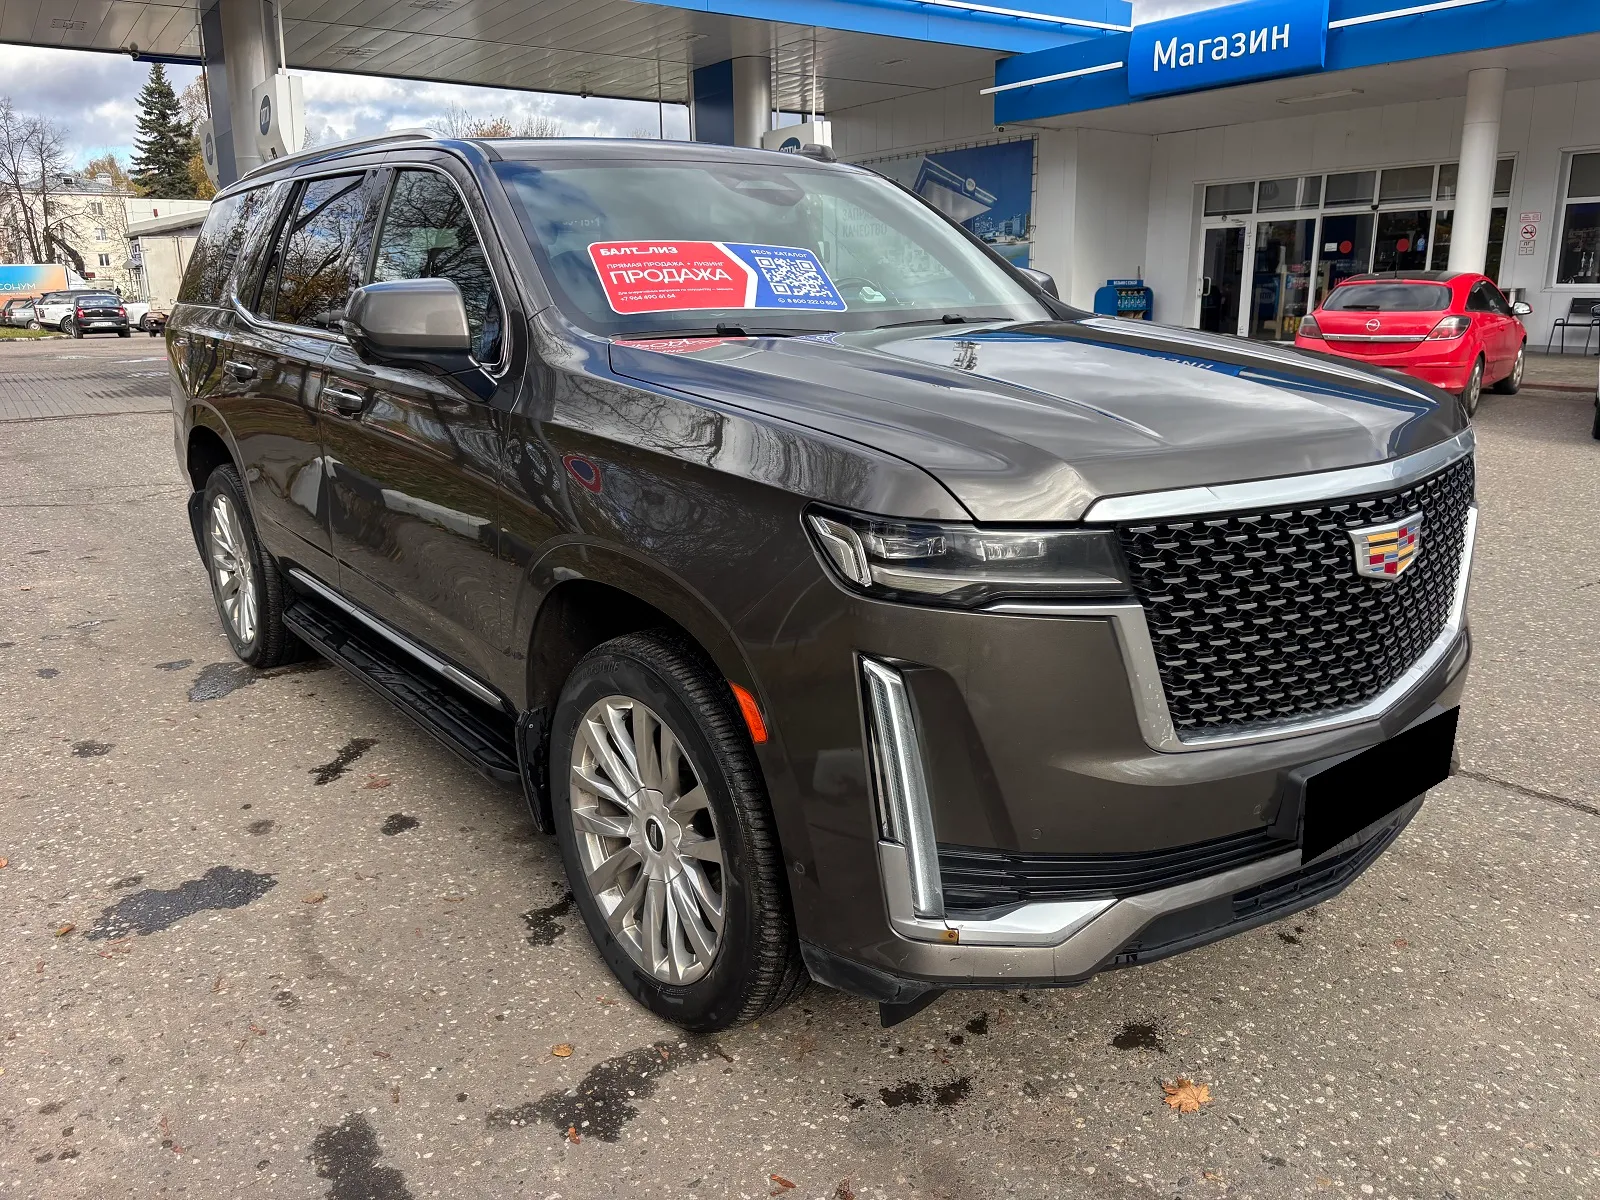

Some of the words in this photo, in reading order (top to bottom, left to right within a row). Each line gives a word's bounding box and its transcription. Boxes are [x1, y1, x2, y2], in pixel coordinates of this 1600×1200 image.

[1153, 23, 1290, 72] Магазин
[842, 223, 888, 238] КАЧЕСТВО
[606, 262, 642, 270] ПРЯМАЯ
[609, 268, 733, 285] ПРОДАЖА
